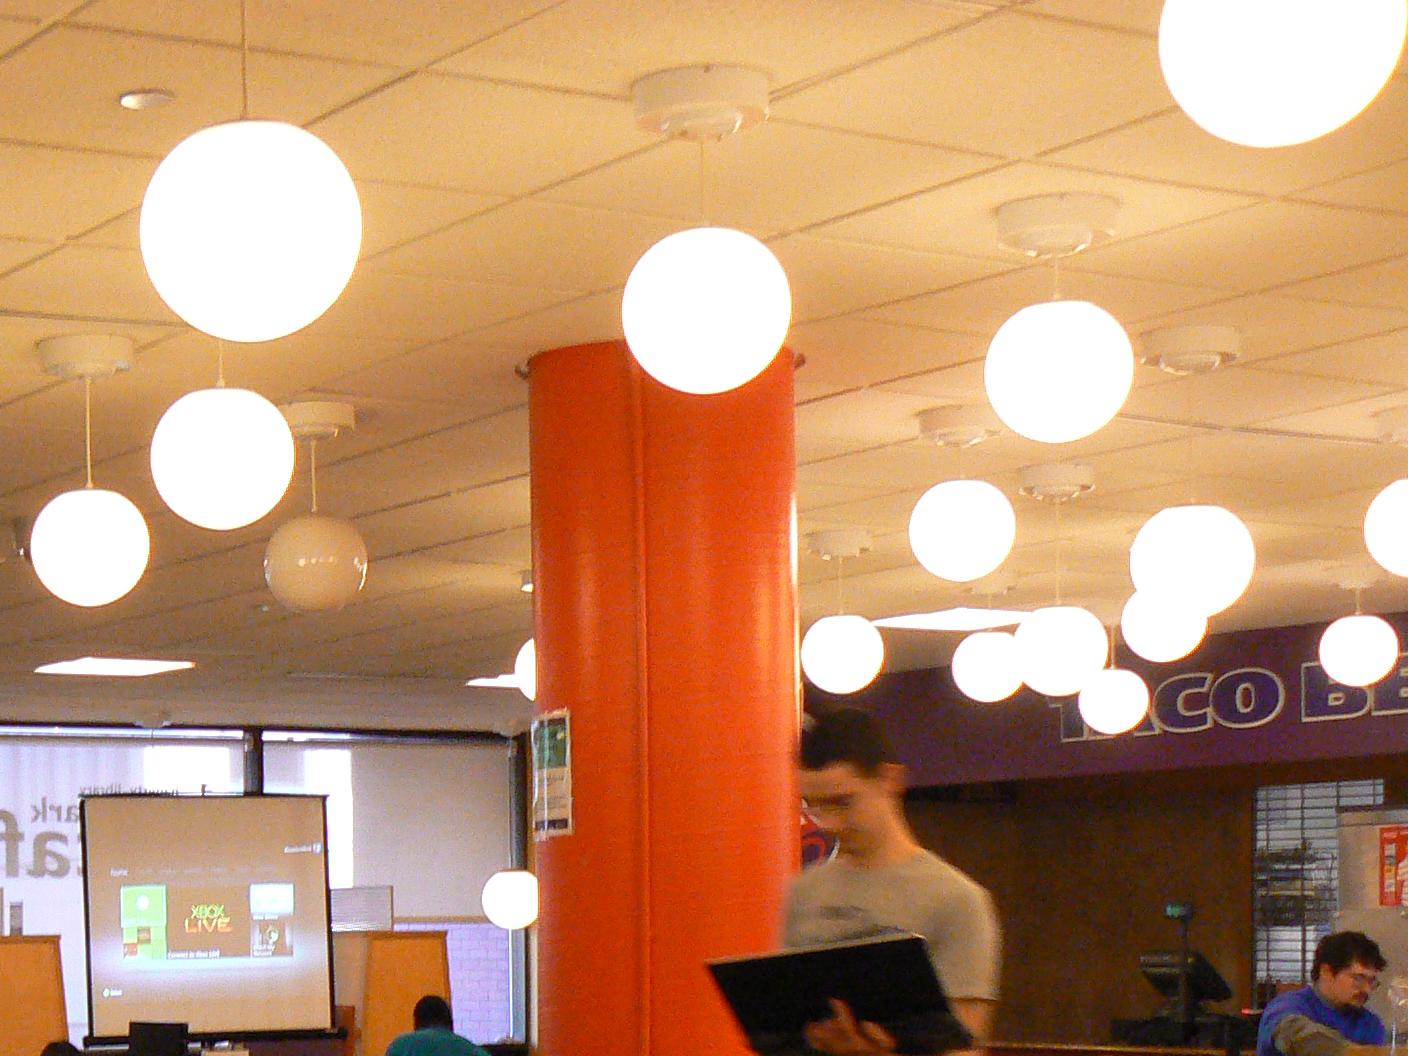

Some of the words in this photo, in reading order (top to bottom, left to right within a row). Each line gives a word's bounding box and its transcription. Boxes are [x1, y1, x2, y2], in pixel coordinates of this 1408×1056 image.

[1048, 667, 1285, 743] TCO
[191, 903, 224, 918] XBOX
[184, 917, 232, 934] LIVE
